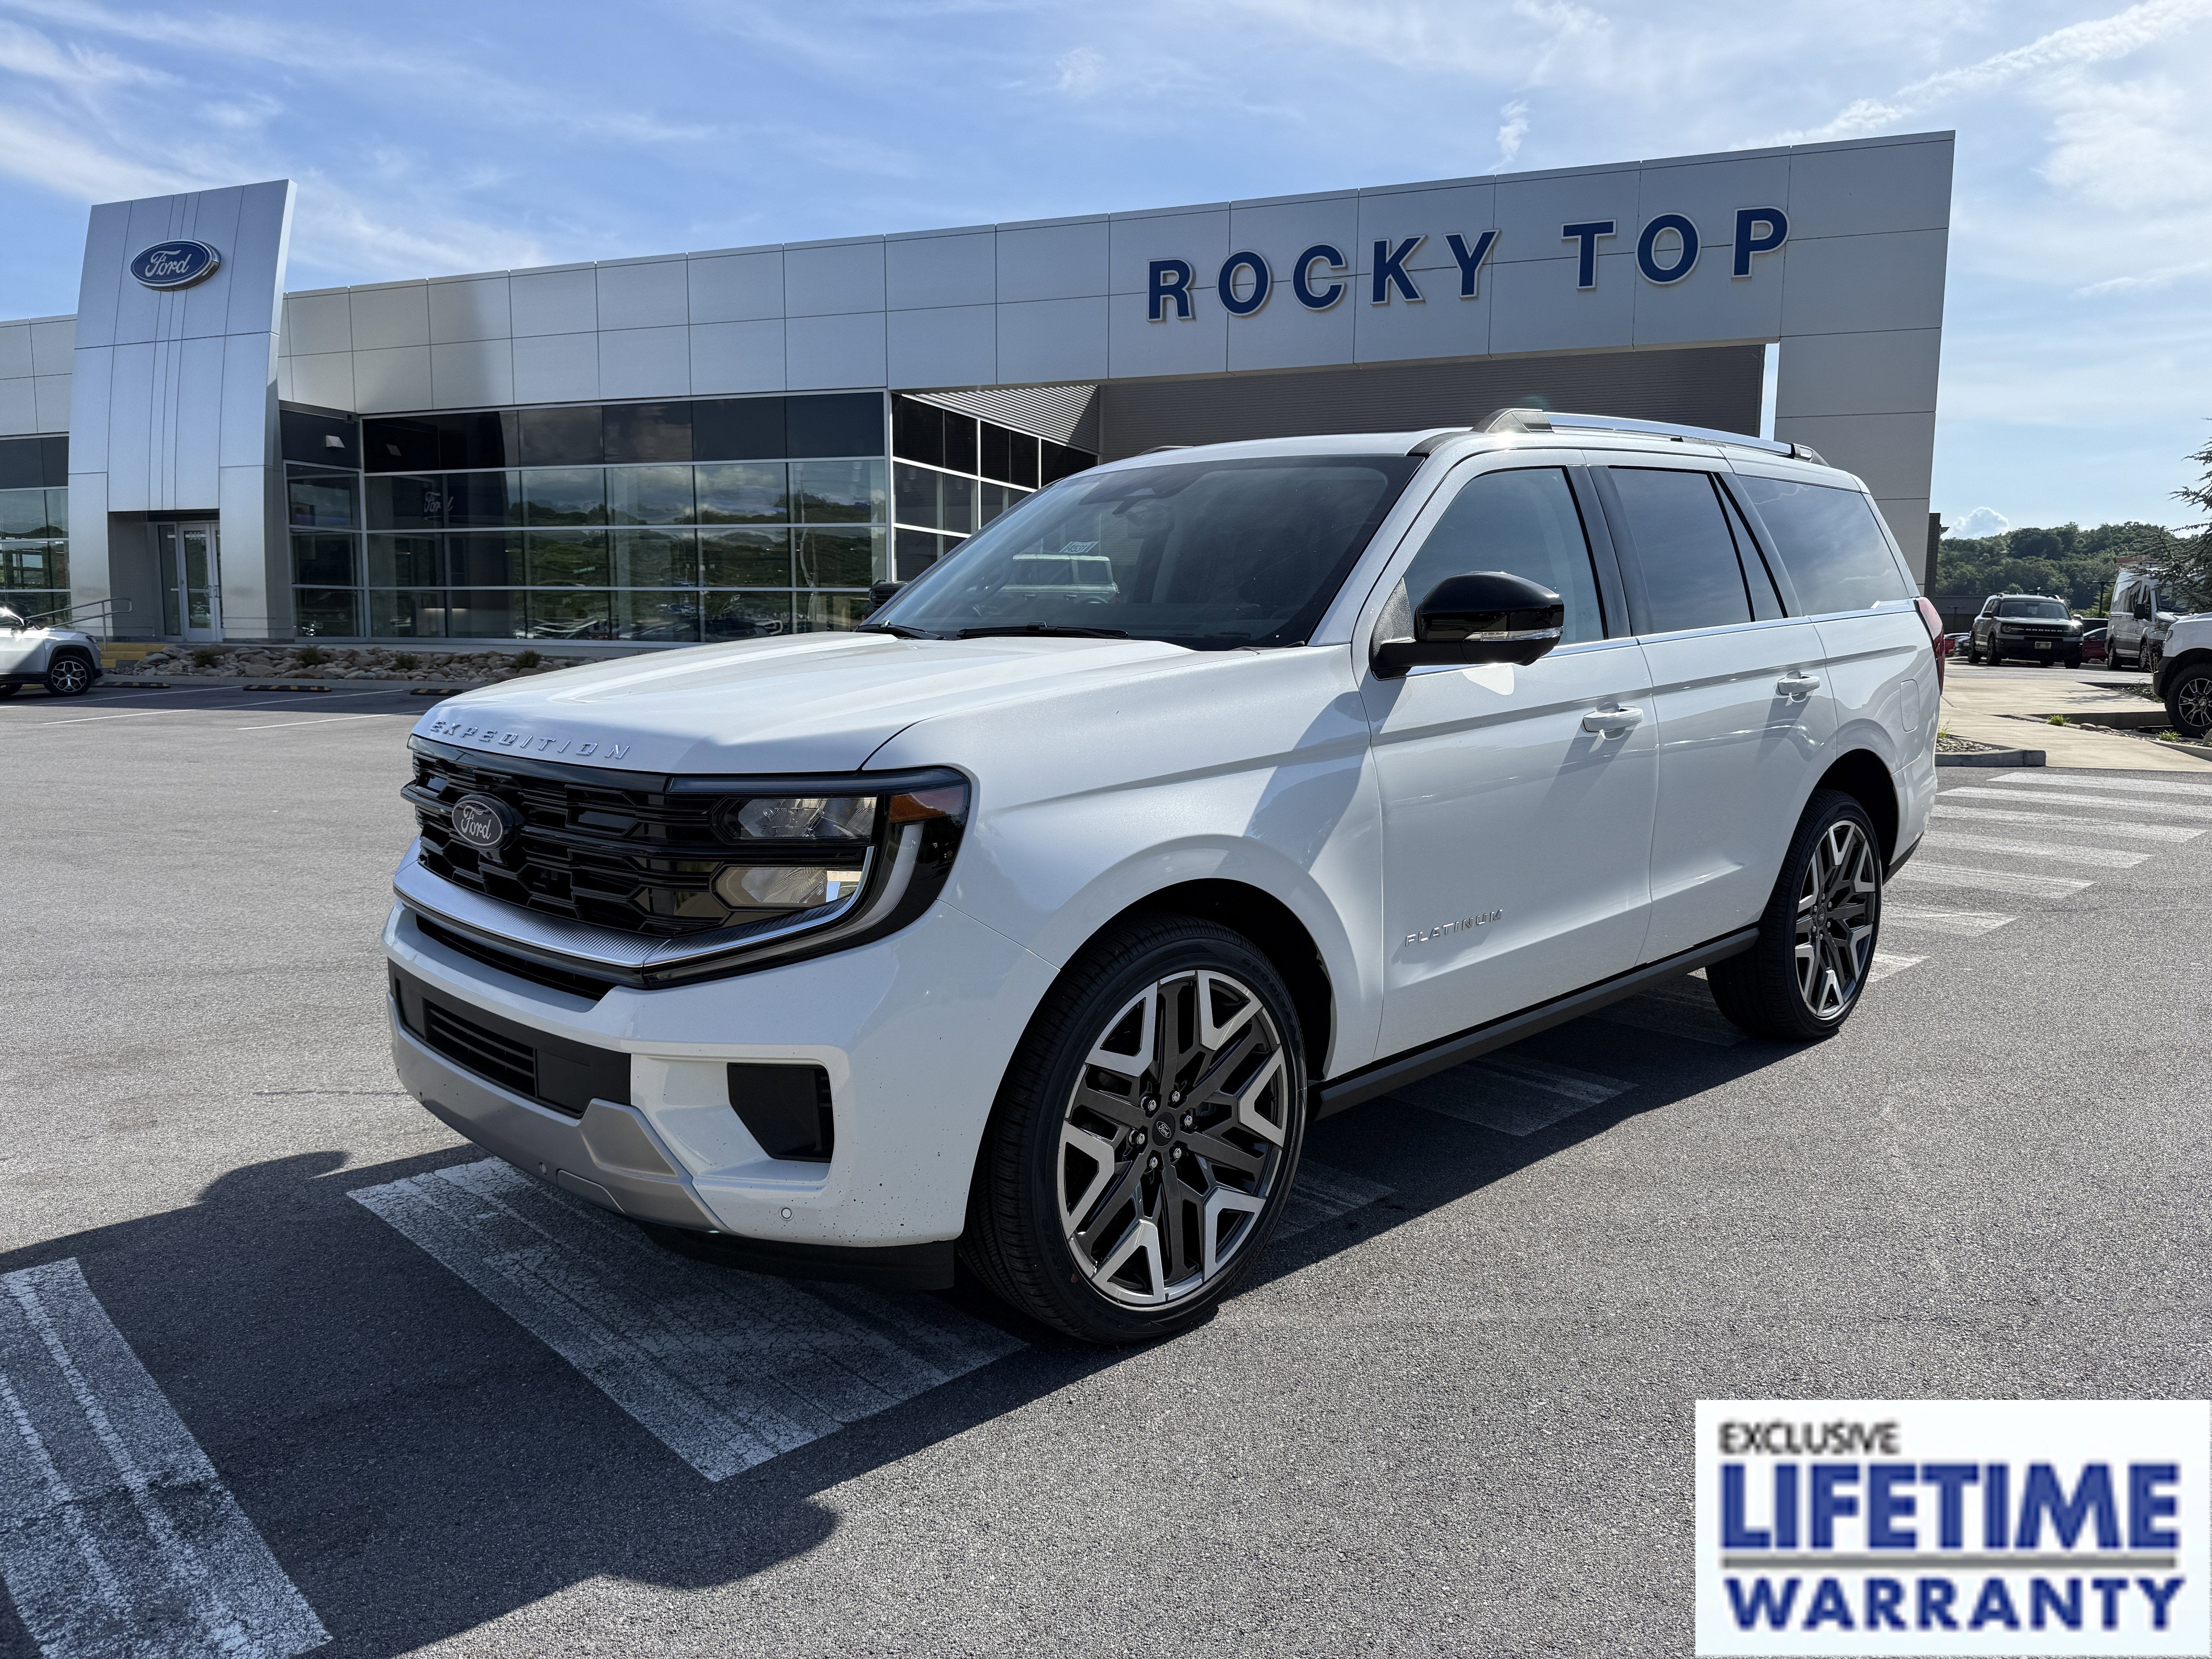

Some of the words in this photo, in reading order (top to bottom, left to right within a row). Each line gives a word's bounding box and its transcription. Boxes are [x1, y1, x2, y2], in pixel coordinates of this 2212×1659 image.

[145, 249, 192, 277] Ford
[1146, 228, 1500, 322] ROCKY
[1561, 206, 1790, 290] TOP
[429, 720, 630, 760] EXPEDITION
[461, 805, 491, 840] Ford
[1405, 909, 1503, 947] PLATINUM
[1159, 1123, 1170, 1136] Ford
